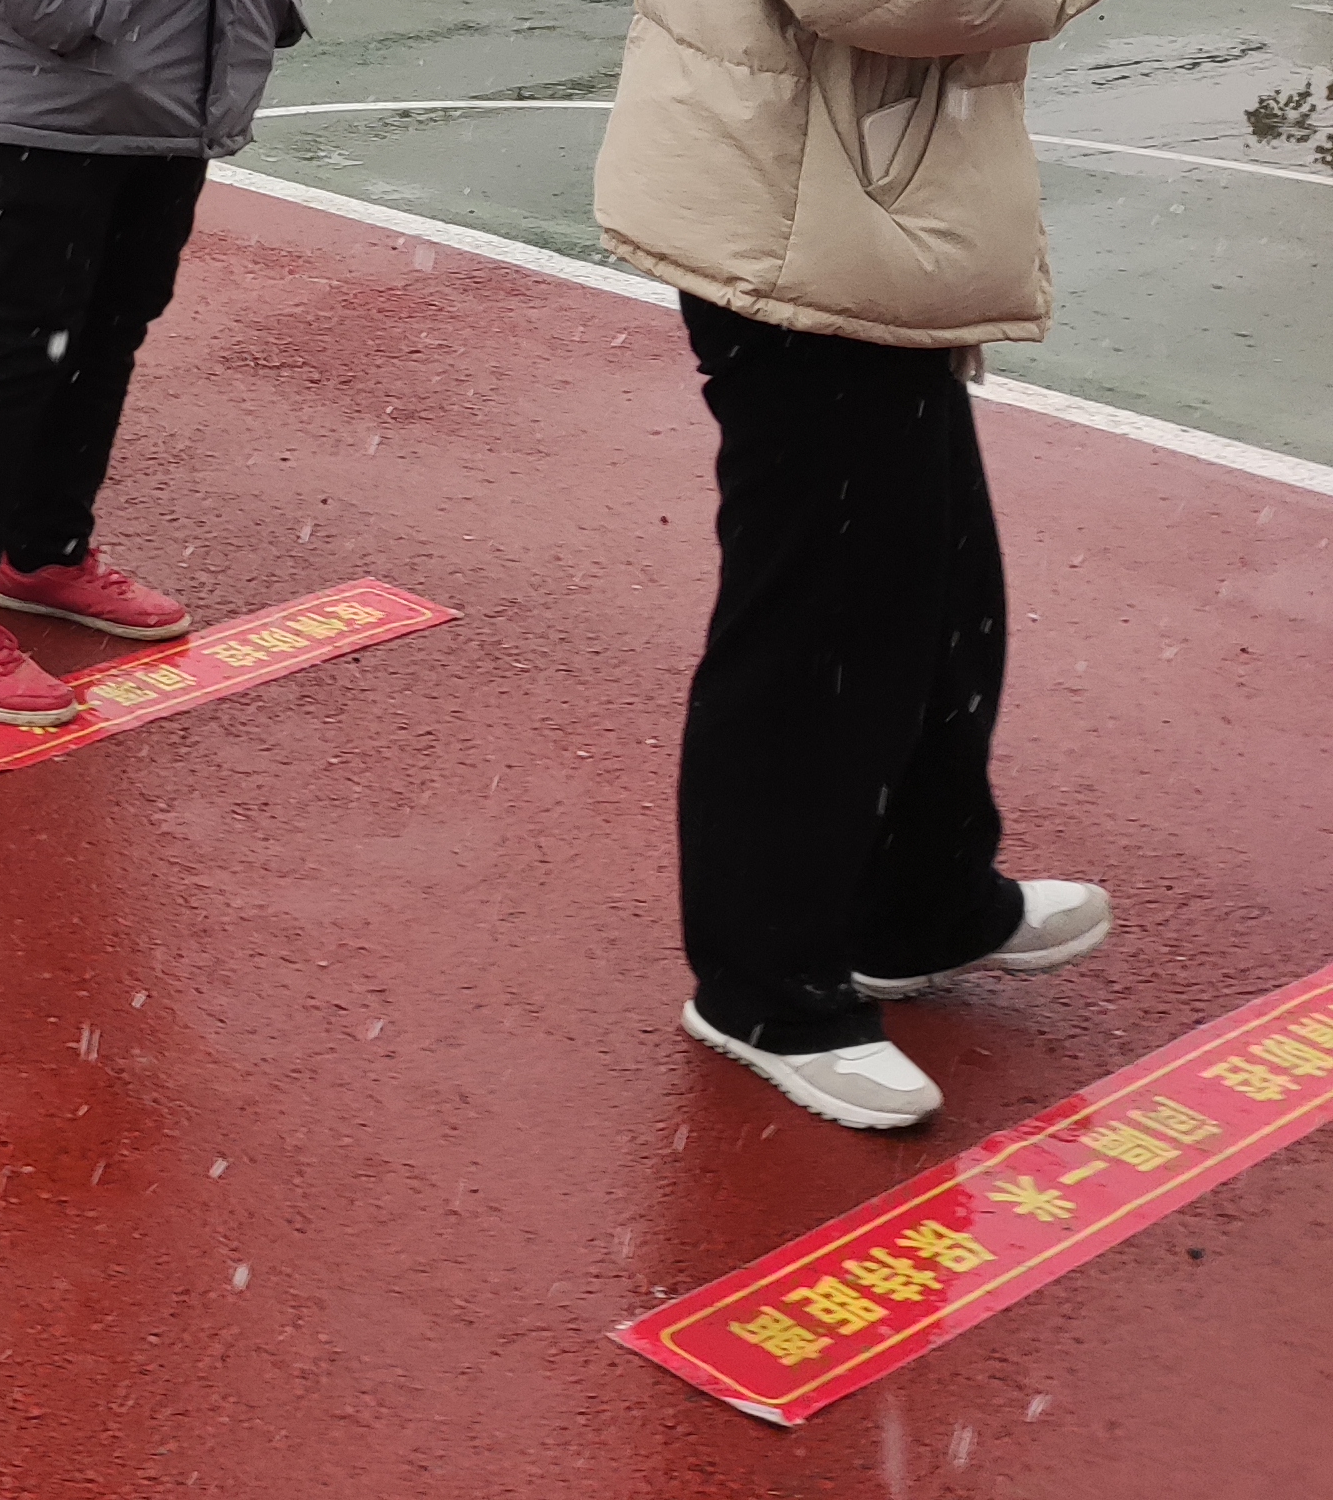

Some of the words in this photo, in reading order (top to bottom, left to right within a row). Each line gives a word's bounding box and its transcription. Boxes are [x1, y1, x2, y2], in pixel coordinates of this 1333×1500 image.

[201, 601, 386, 668] 疫情防控
[1198, 1003, 1333, 1103] 防控
[986, 1095, 1222, 1223] 间隔一米
[728, 1219, 997, 1367] 保持距离
